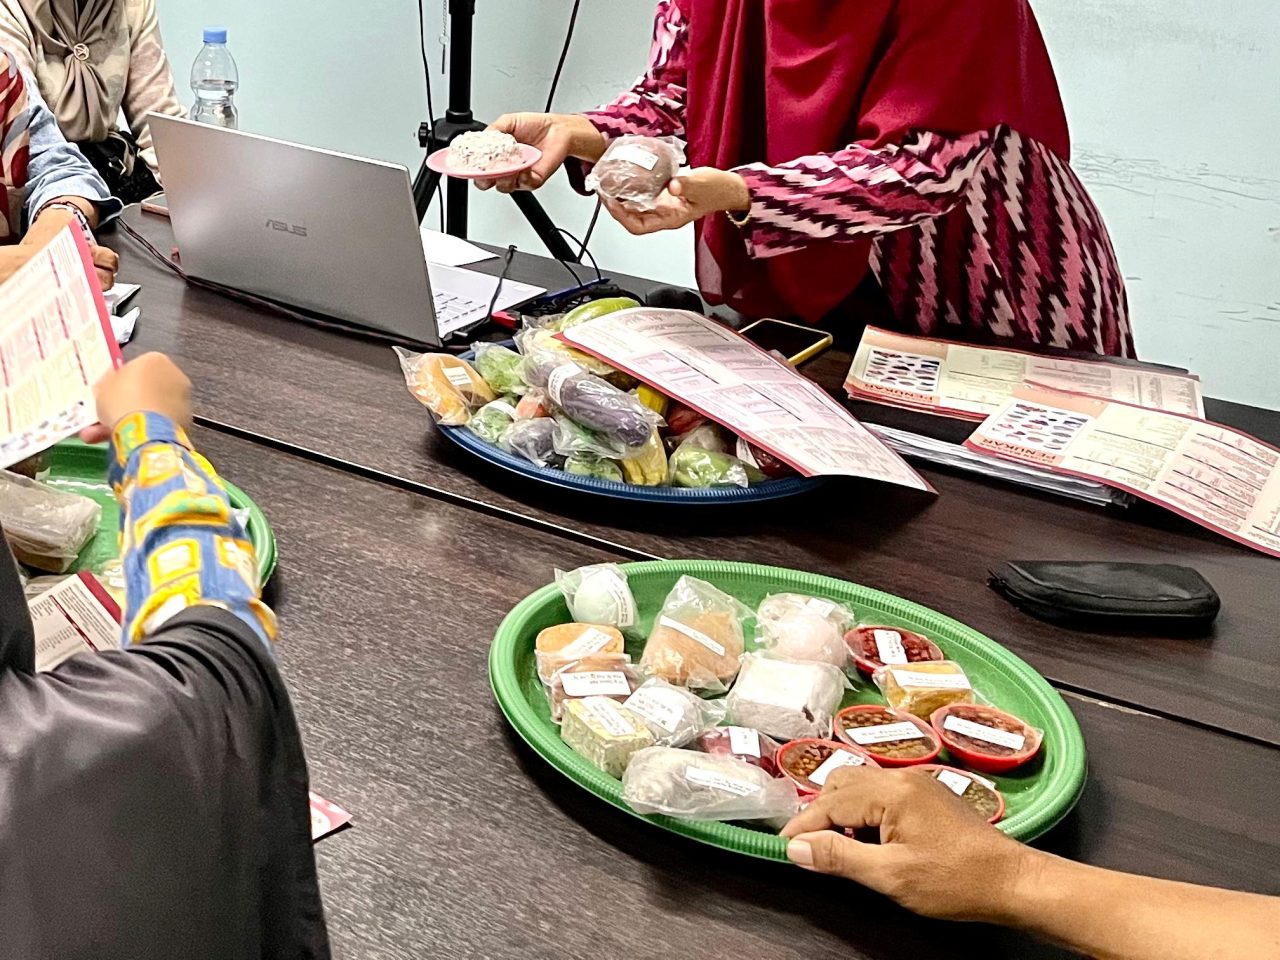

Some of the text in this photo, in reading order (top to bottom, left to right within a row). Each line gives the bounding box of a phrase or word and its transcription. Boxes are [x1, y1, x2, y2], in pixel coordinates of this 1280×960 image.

[265, 219, 307, 237] ASUS
[864, 384, 933, 401] PENUKAR
[982, 438, 1056, 460] PENUKAR
